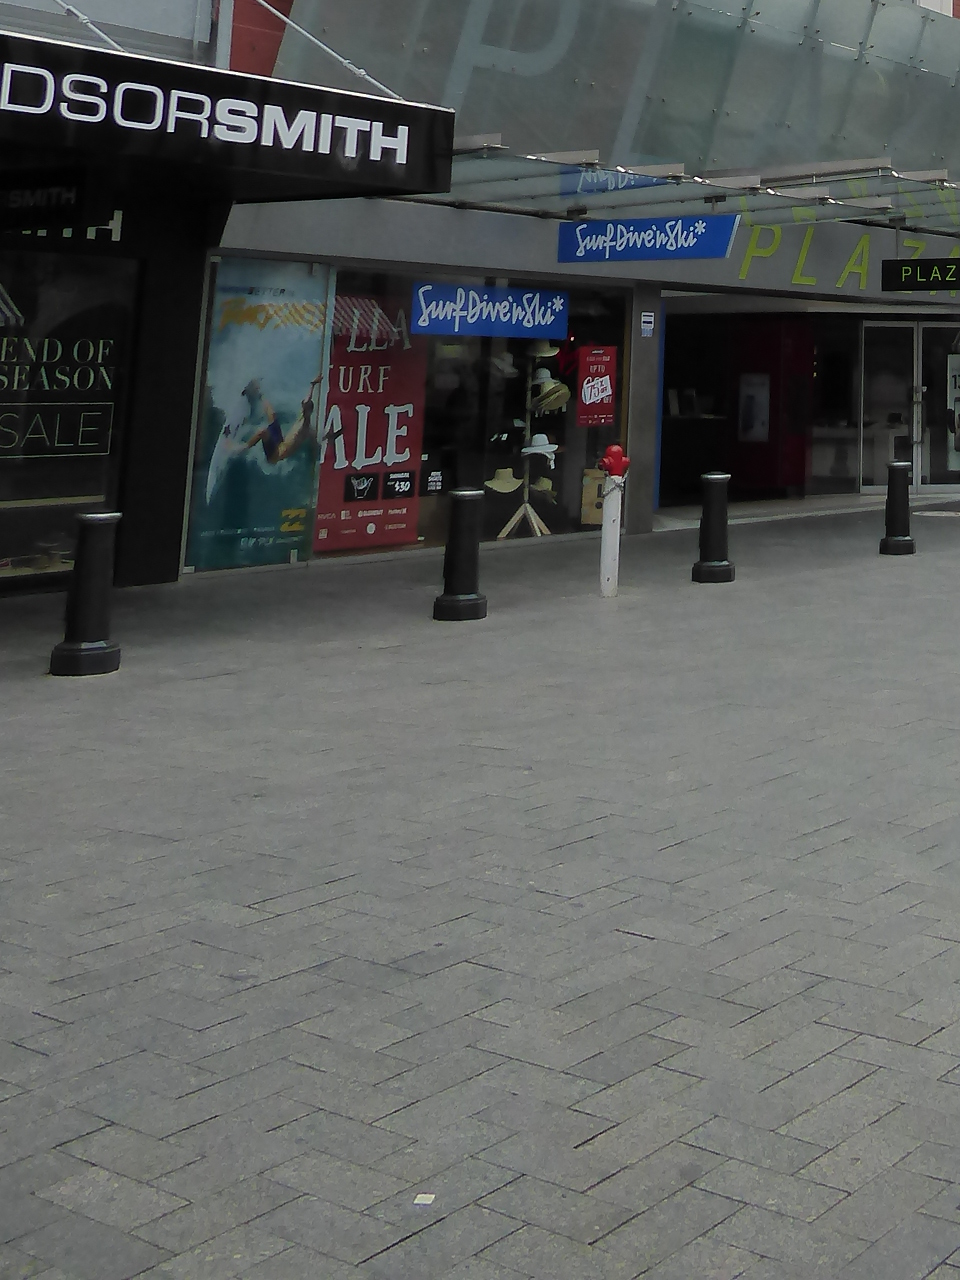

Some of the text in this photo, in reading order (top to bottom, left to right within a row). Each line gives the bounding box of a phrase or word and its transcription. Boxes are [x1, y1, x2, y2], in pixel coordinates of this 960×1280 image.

[0, 63, 409, 164] DSORSMITH
[0, 337, 114, 364] END OF
[0, 365, 115, 391] SEASON
[329, 365, 391, 393] URF
[0, 412, 102, 449] SALE
[394, 481, 411, 492] $30
